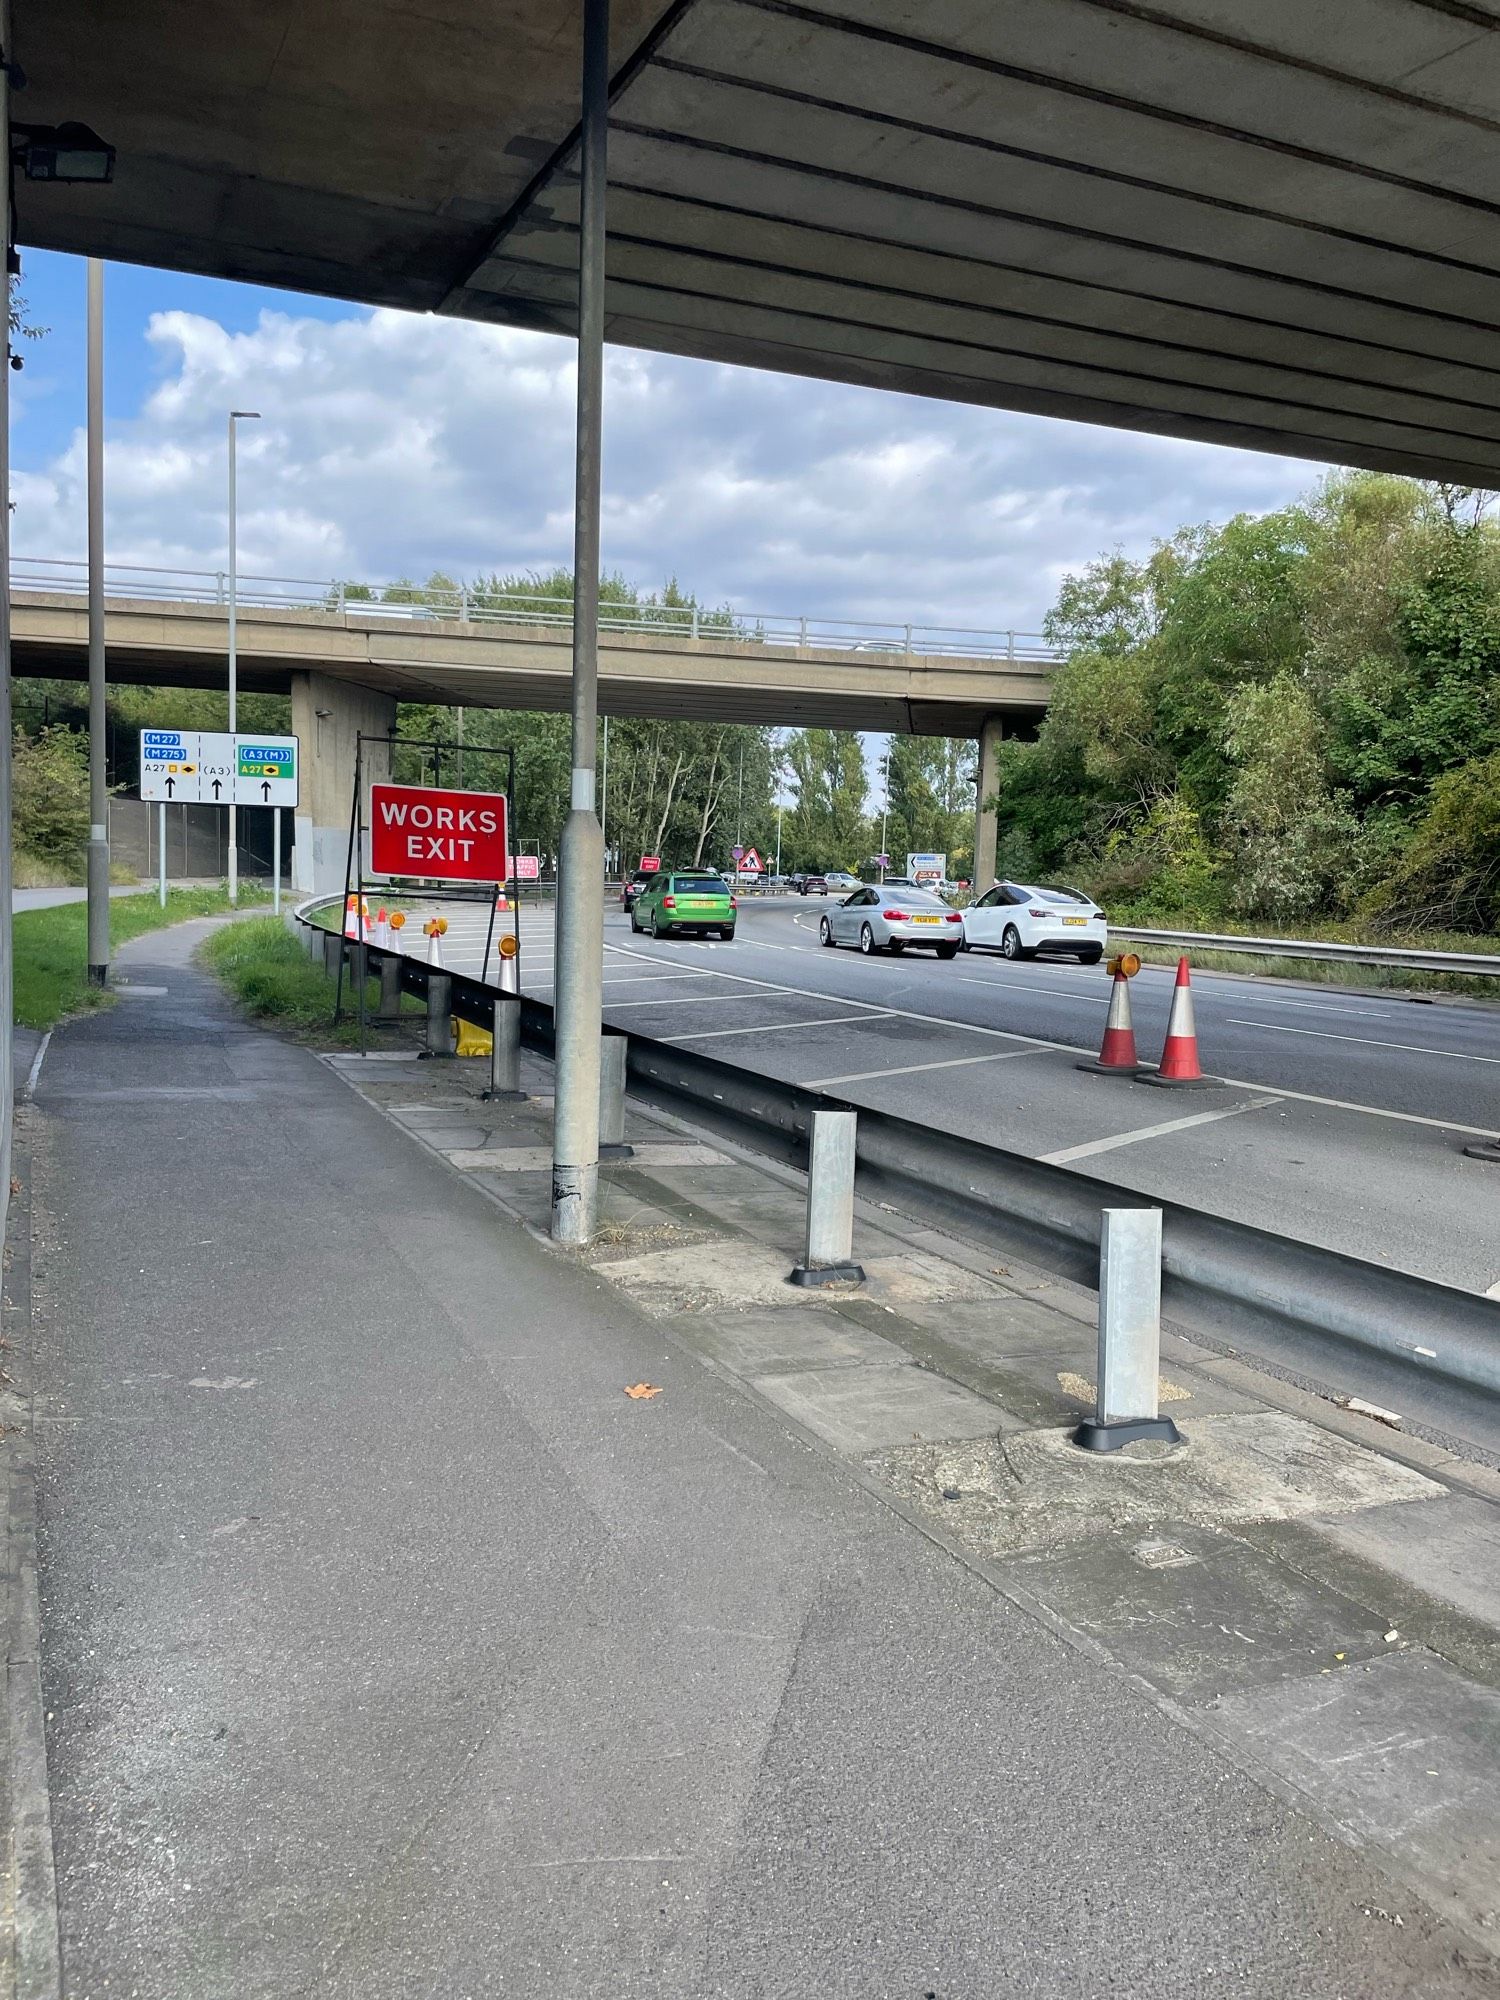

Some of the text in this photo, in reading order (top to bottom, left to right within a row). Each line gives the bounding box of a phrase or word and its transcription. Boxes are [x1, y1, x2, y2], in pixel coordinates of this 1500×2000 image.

[145, 734, 179, 744] (M27)
[145, 748, 186, 760] (M275)
[242, 749, 290, 761] (A3(M))
[145, 764, 165, 773] A27
[203, 766, 231, 776] (A3)
[241, 765, 261, 774] A27
[380, 802, 497, 833] WORKS
[407, 835, 475, 862] EXIT
